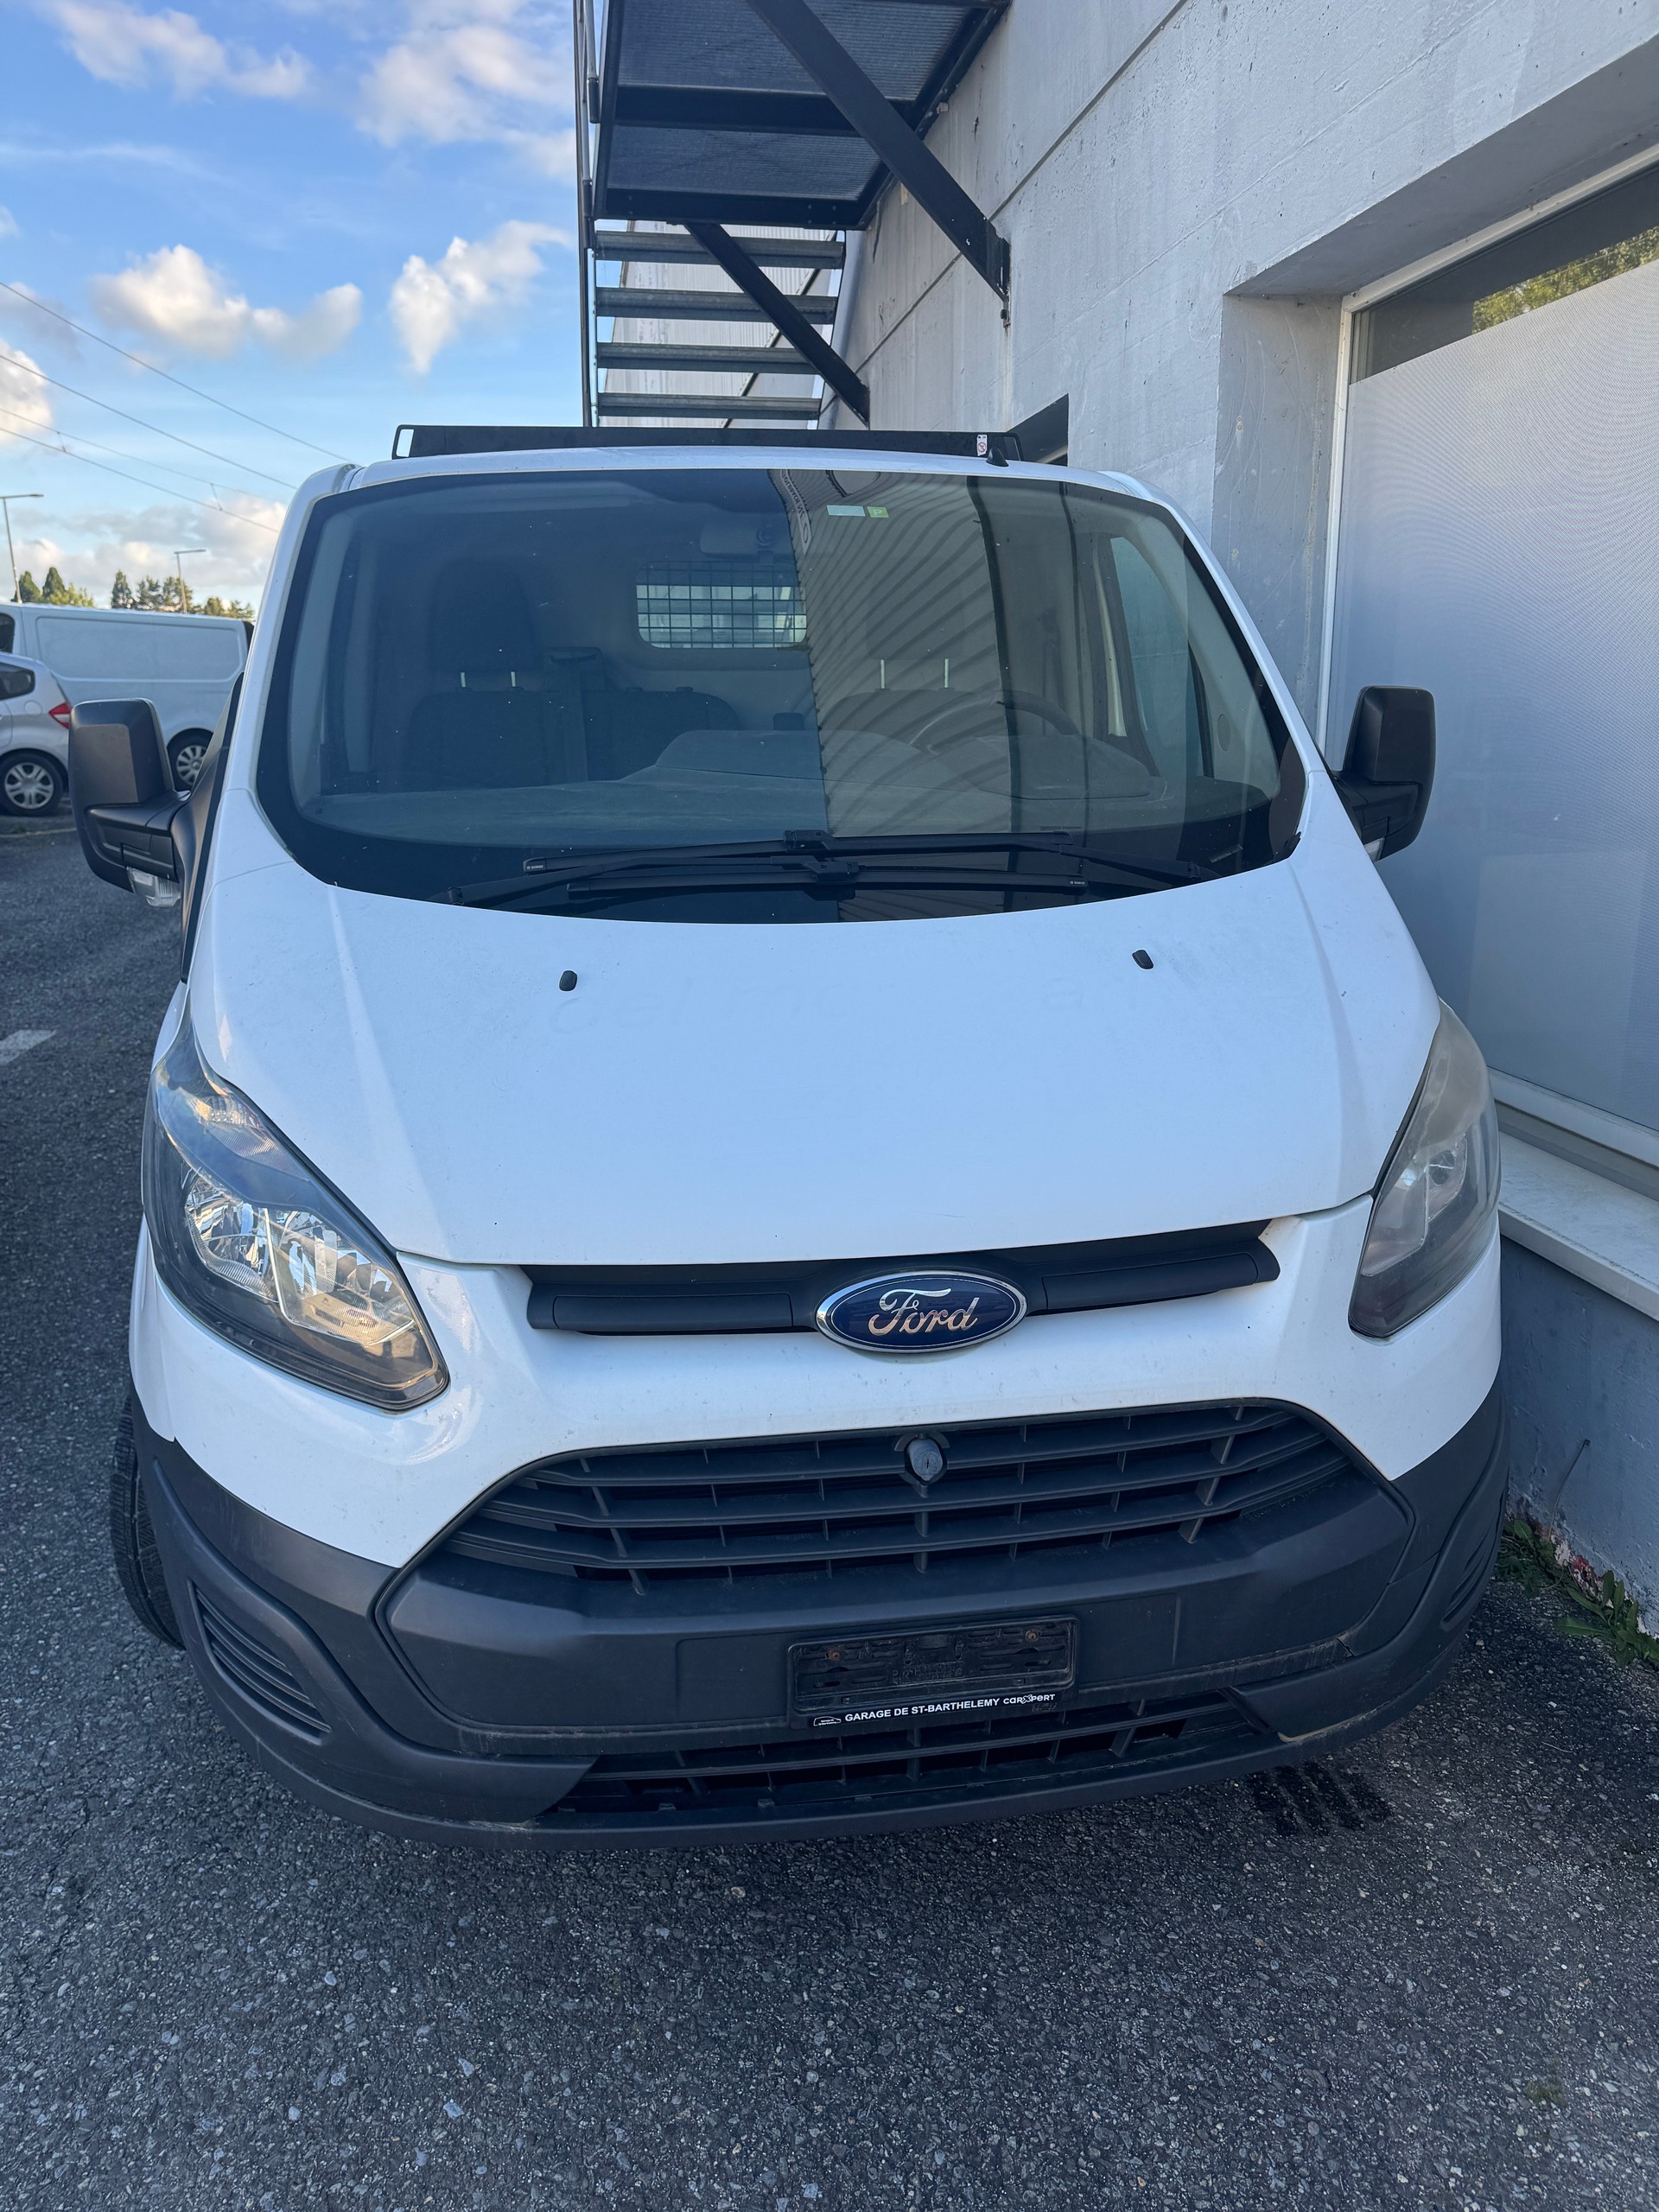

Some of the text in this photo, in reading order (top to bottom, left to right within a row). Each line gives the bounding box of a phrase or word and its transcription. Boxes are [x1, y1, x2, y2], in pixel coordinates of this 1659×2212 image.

[868, 1287, 980, 1337] Ford
[844, 1709, 892, 1722] GARAGE
[893, 1707, 909, 1716] DE
[911, 1697, 1000, 1715] ST-BARTHELEMY
